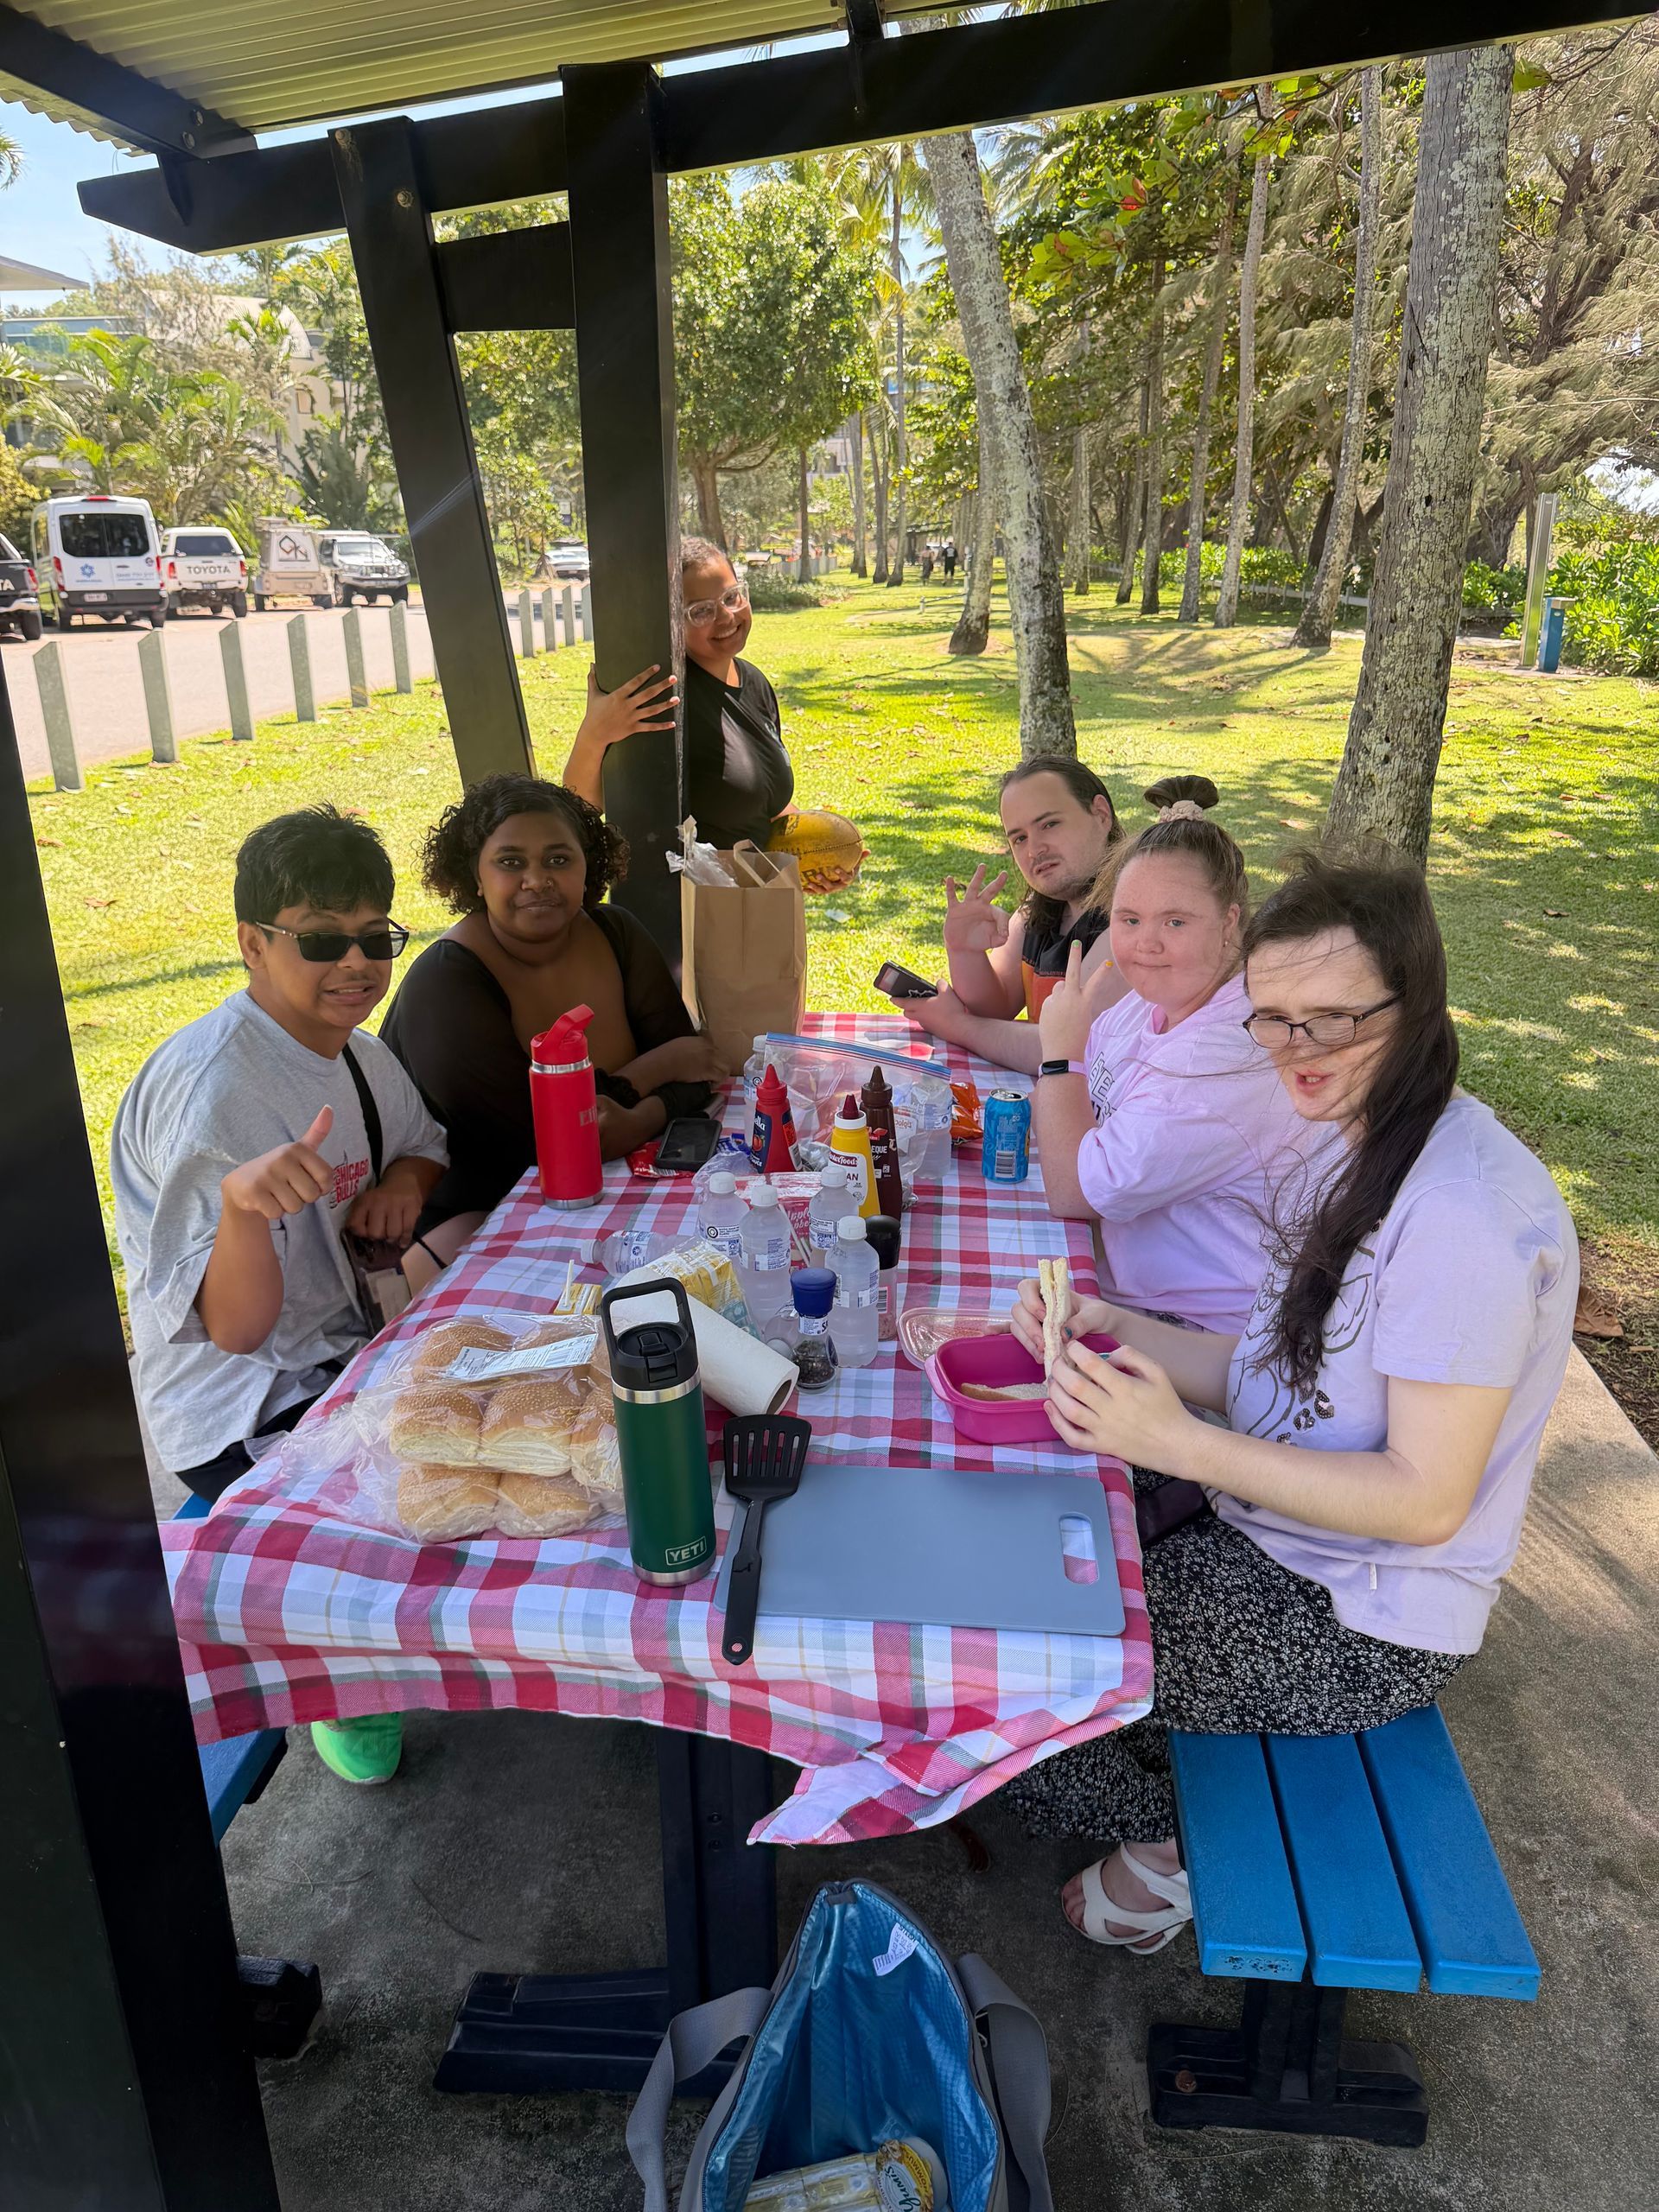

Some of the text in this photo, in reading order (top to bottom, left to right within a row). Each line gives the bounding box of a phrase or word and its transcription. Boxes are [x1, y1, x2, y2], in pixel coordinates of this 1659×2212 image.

[187, 566, 232, 575] TOYOTA
[336, 1179, 359, 1204] BULLS
[669, 1541, 704, 1562] YETI
